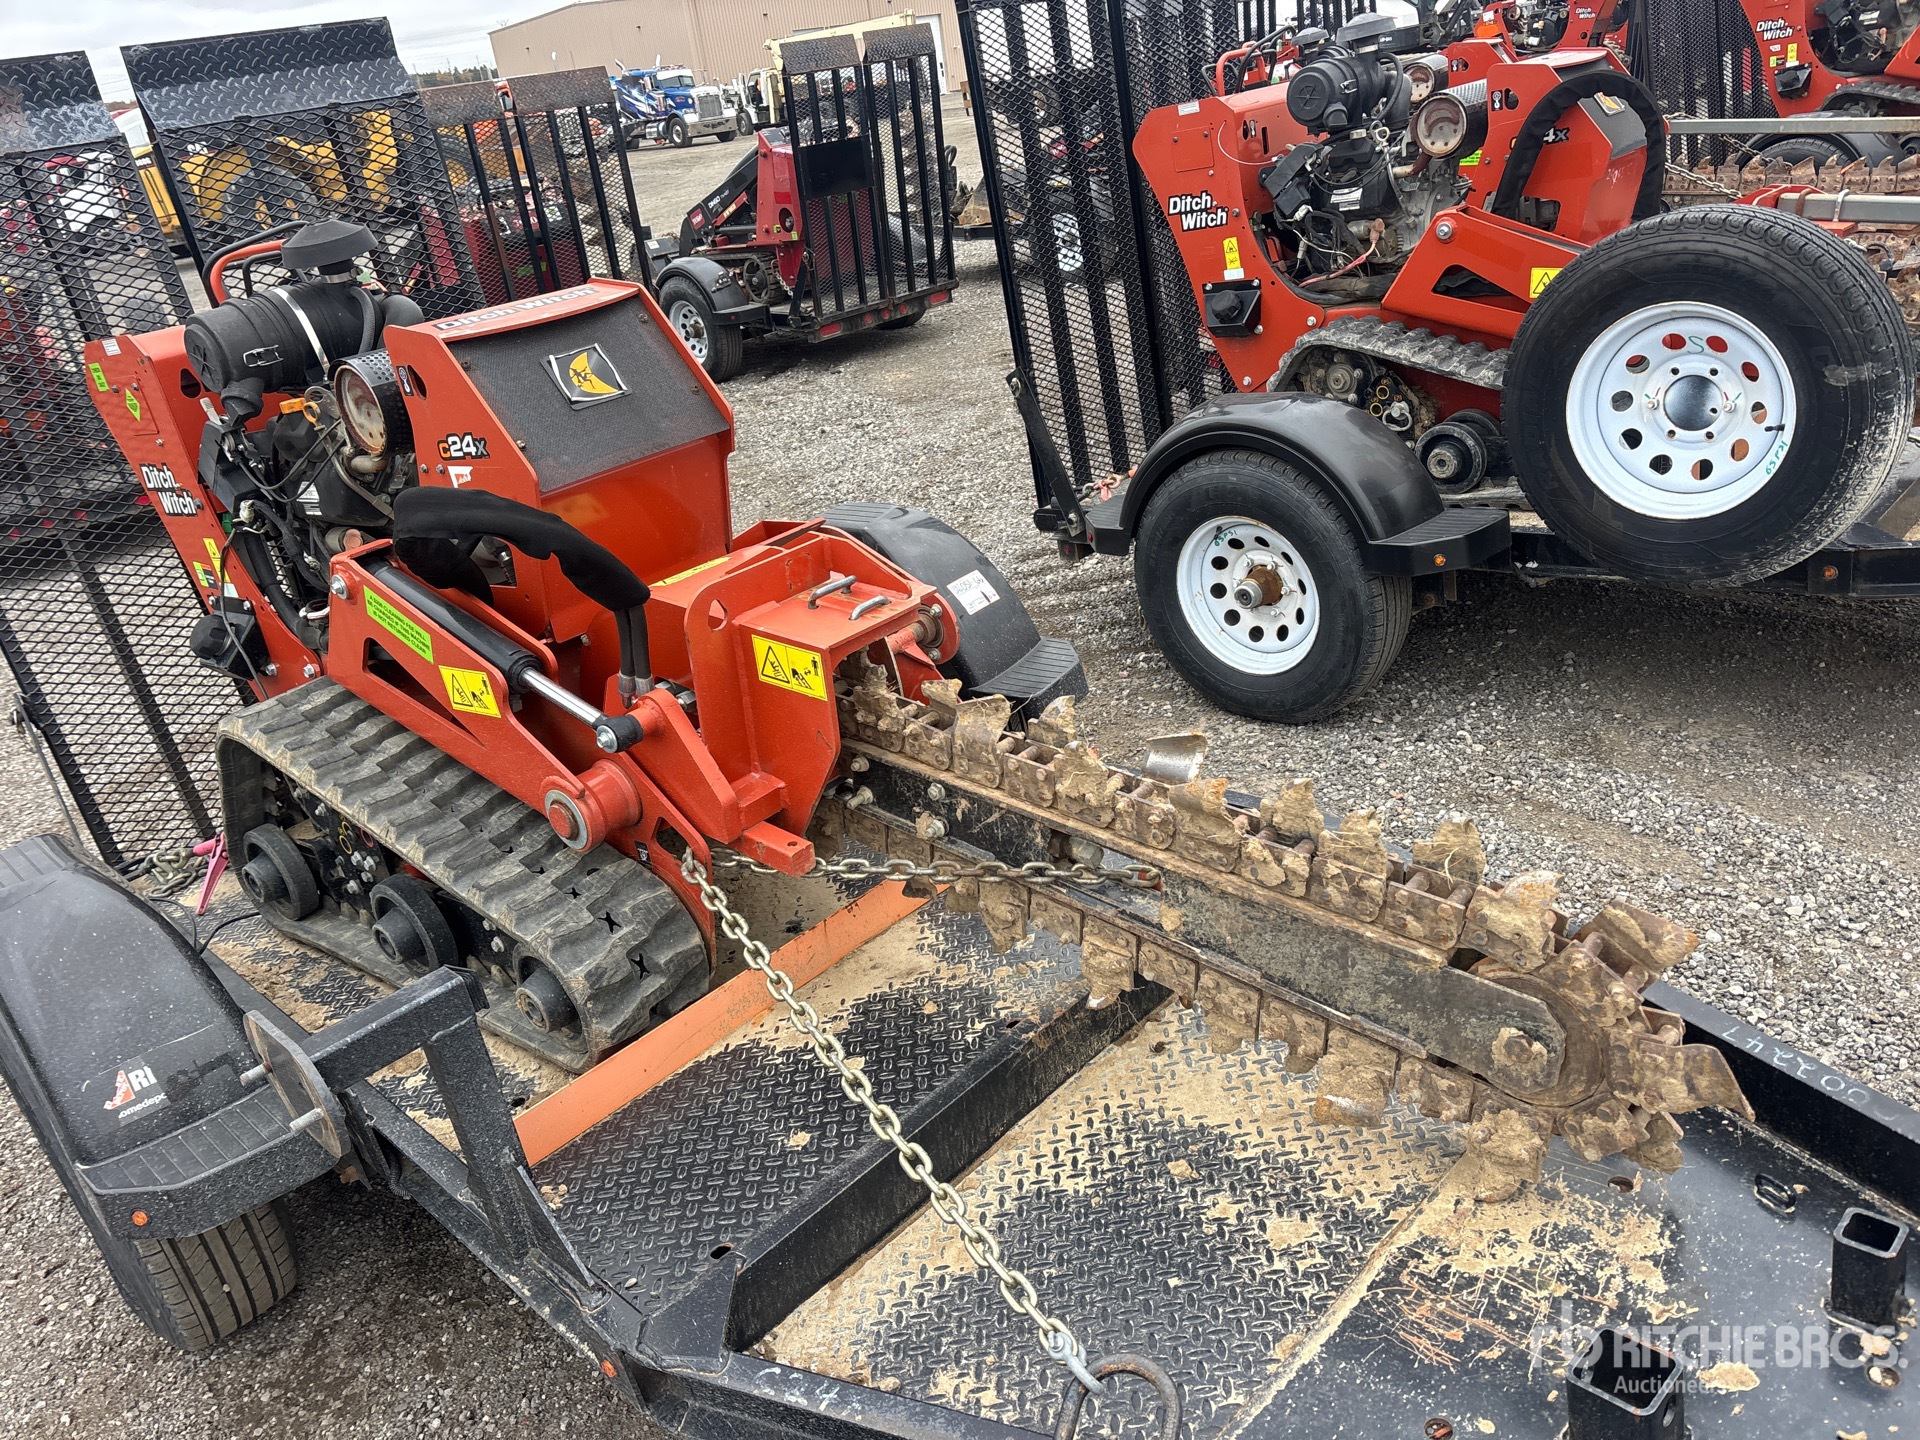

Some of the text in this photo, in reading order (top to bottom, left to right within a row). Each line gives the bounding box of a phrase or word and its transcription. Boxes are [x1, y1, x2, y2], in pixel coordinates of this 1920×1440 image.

[1755, 18, 1785, 32] Ditch
[1763, 27, 1793, 41] Witch
[1168, 192, 1212, 214] Ditch
[1181, 208, 1227, 230] Witch
[437, 287, 594, 330] Ditch Witch
[141, 465, 175, 489] Ditch
[158, 491, 197, 514] Witch
